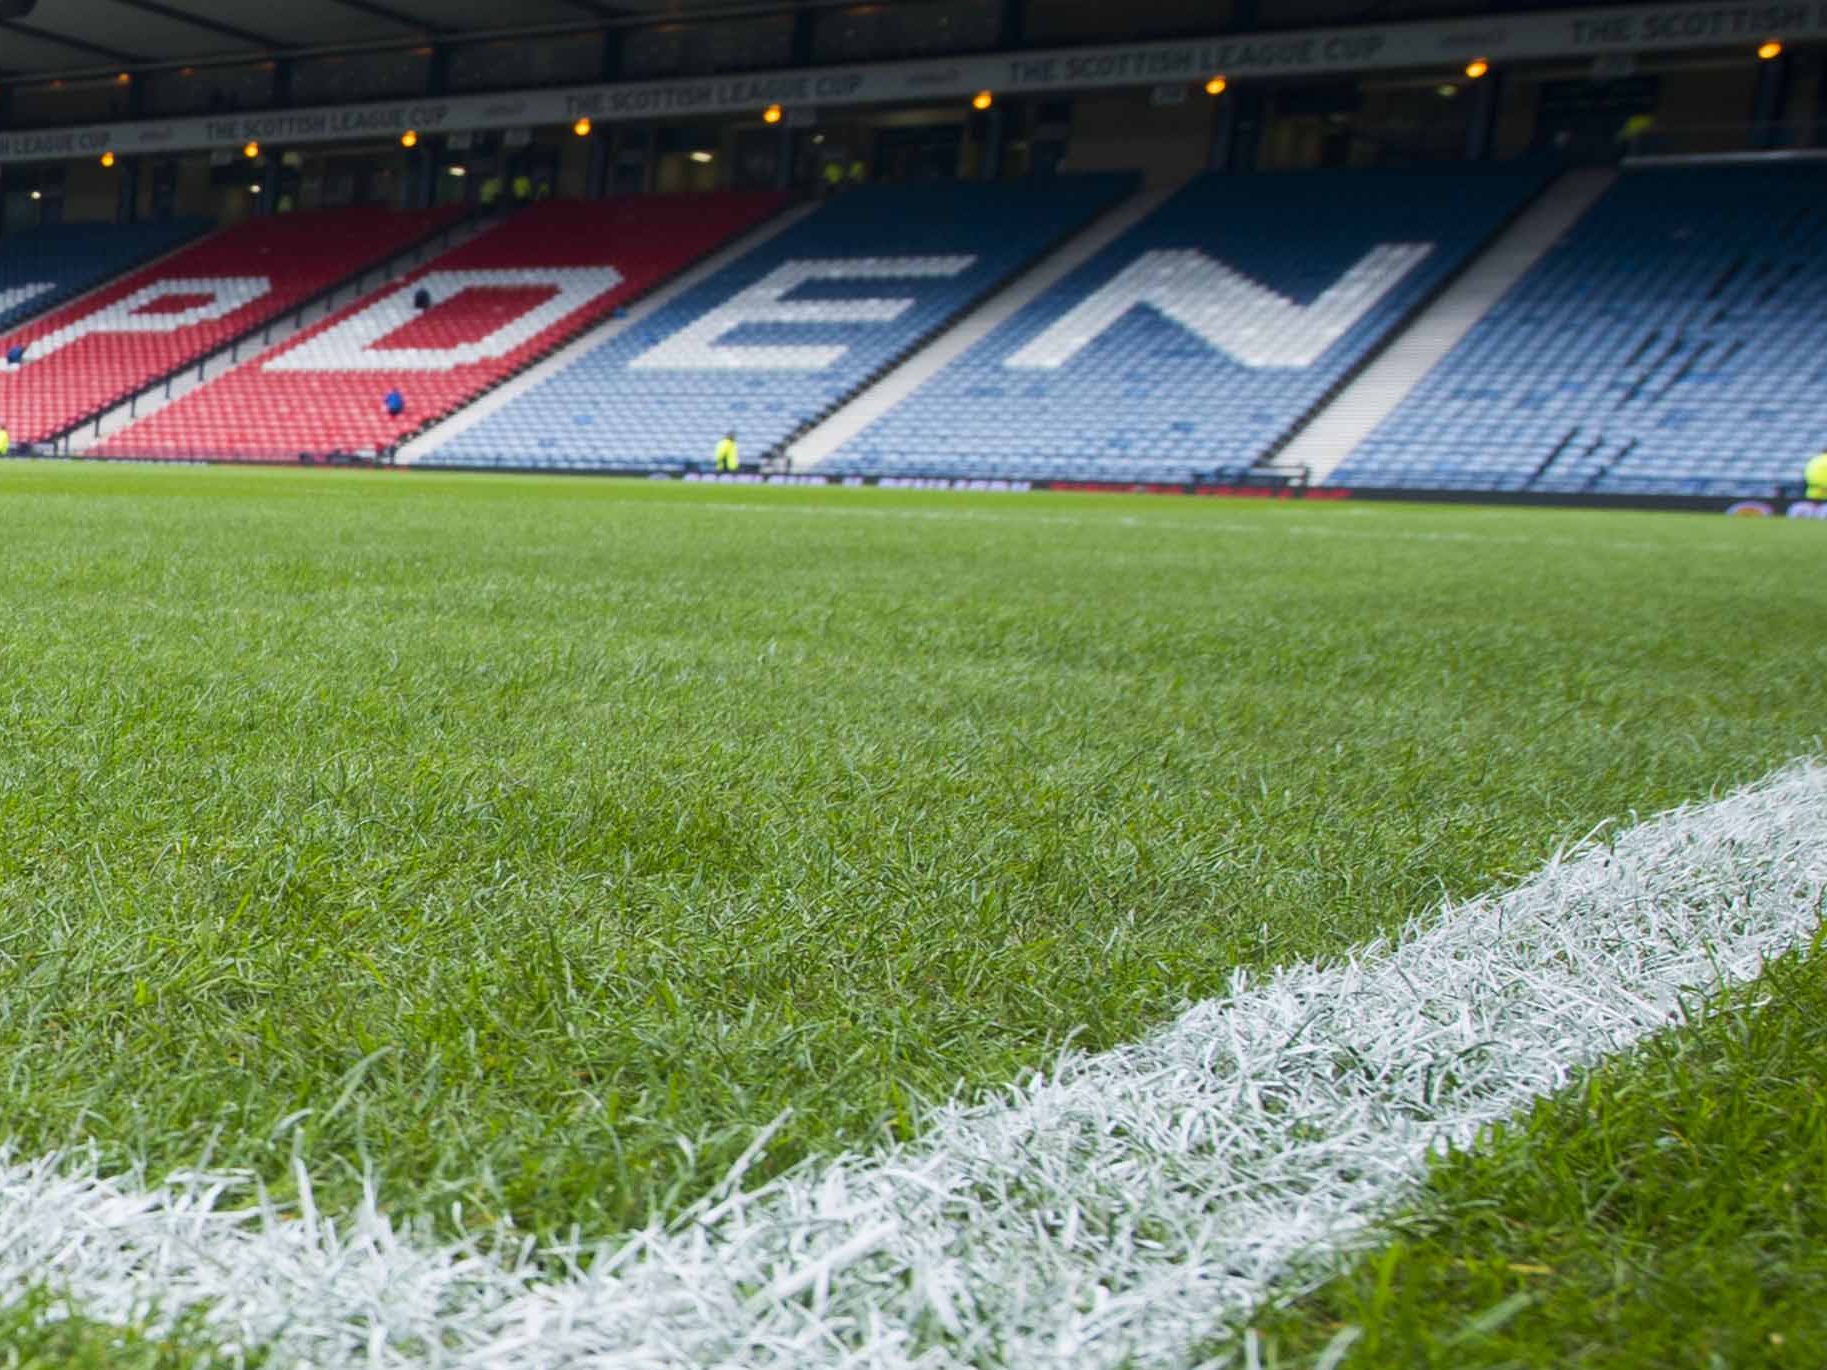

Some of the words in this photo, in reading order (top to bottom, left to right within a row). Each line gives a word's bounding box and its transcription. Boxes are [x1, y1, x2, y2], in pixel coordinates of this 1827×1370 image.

[1008, 59, 1058, 82] THE
[1065, 50, 1191, 78] SCOTTISH
[1198, 40, 1315, 70] LEAGUE
[1322, 36, 1387, 60] CUP
[566, 94, 605, 115] THE
[611, 85, 712, 111] SCOTTISH
[717, 77, 809, 104] LEAGUE
[814, 73, 864, 97] CUP
[13, 133, 73, 153] LEAGUE
[77, 129, 111, 149] CUP
[206, 121, 237, 141] THE
[243, 112, 326, 138] SCOTTISH
[330, 106, 401, 131] LEAGUE
[406, 103, 448, 126] CUP
